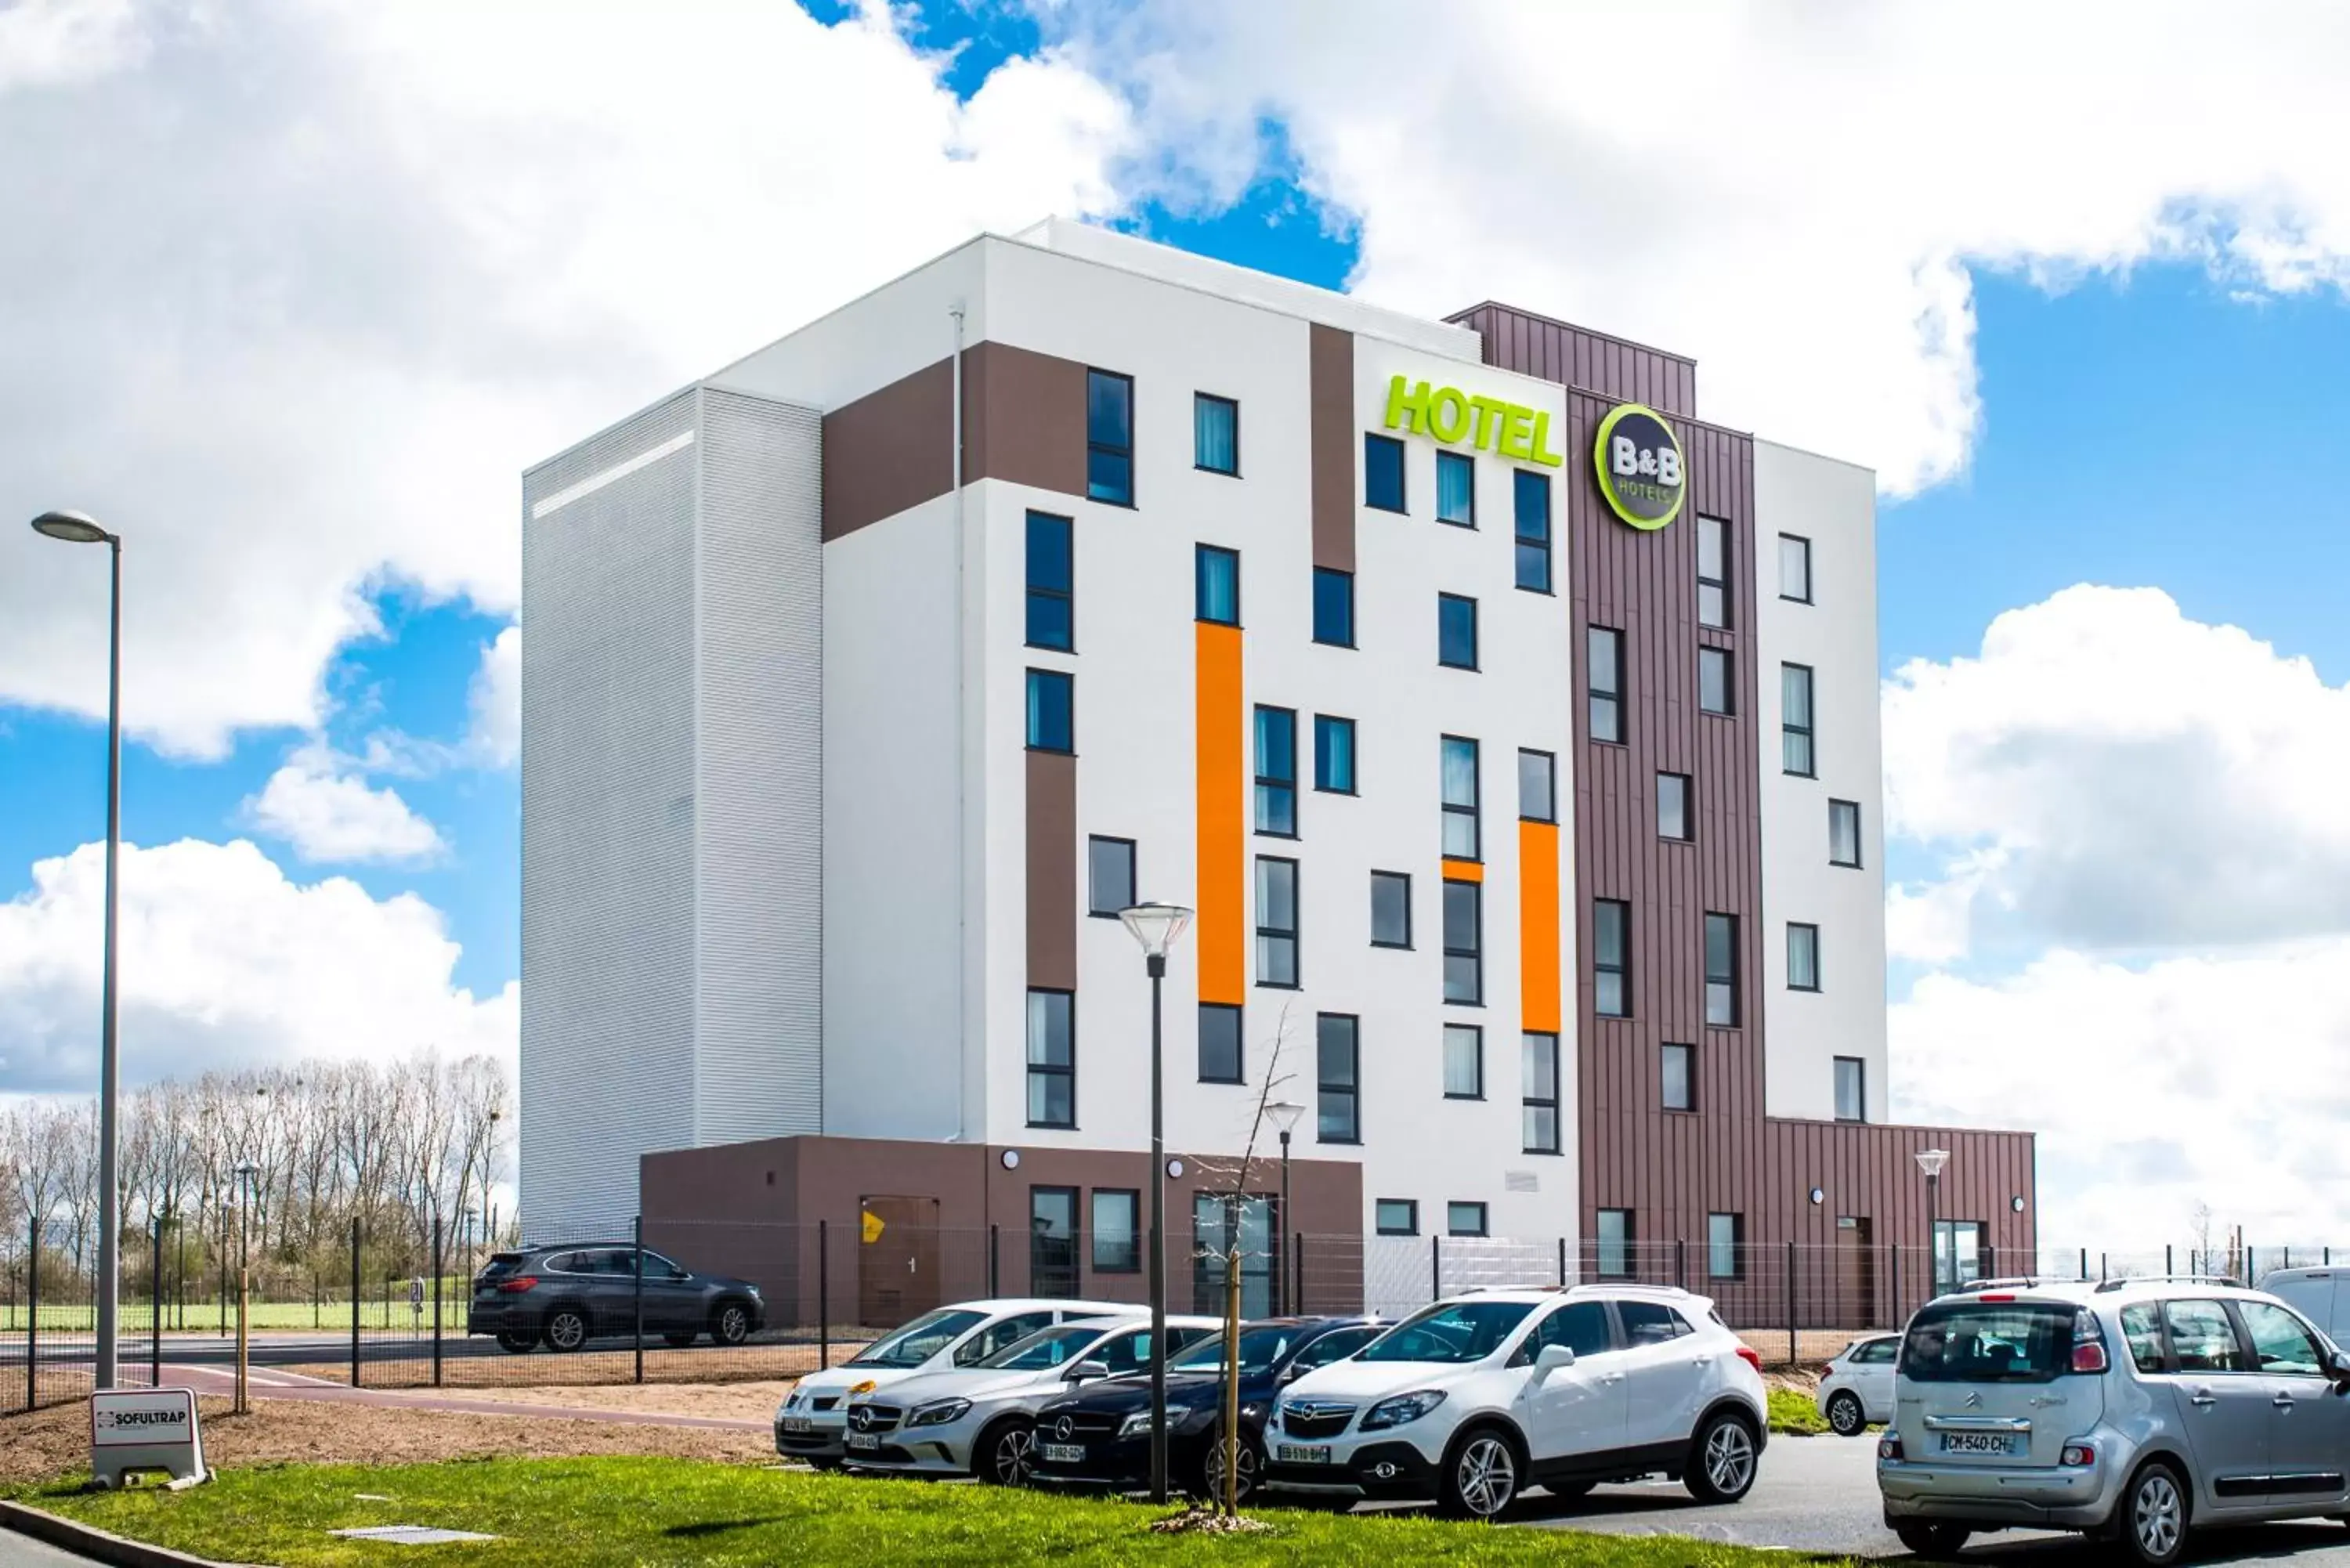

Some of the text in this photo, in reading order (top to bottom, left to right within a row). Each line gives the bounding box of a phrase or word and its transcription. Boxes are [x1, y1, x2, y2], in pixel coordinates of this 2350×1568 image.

[1384, 374, 1564, 468] HOTEL
[1613, 434, 1682, 486] B&B
[1618, 478, 1672, 505] HOTELS
[115, 1411, 186, 1425] SOFULTRAP
[1948, 1434, 2006, 1451] CM-540-CH
